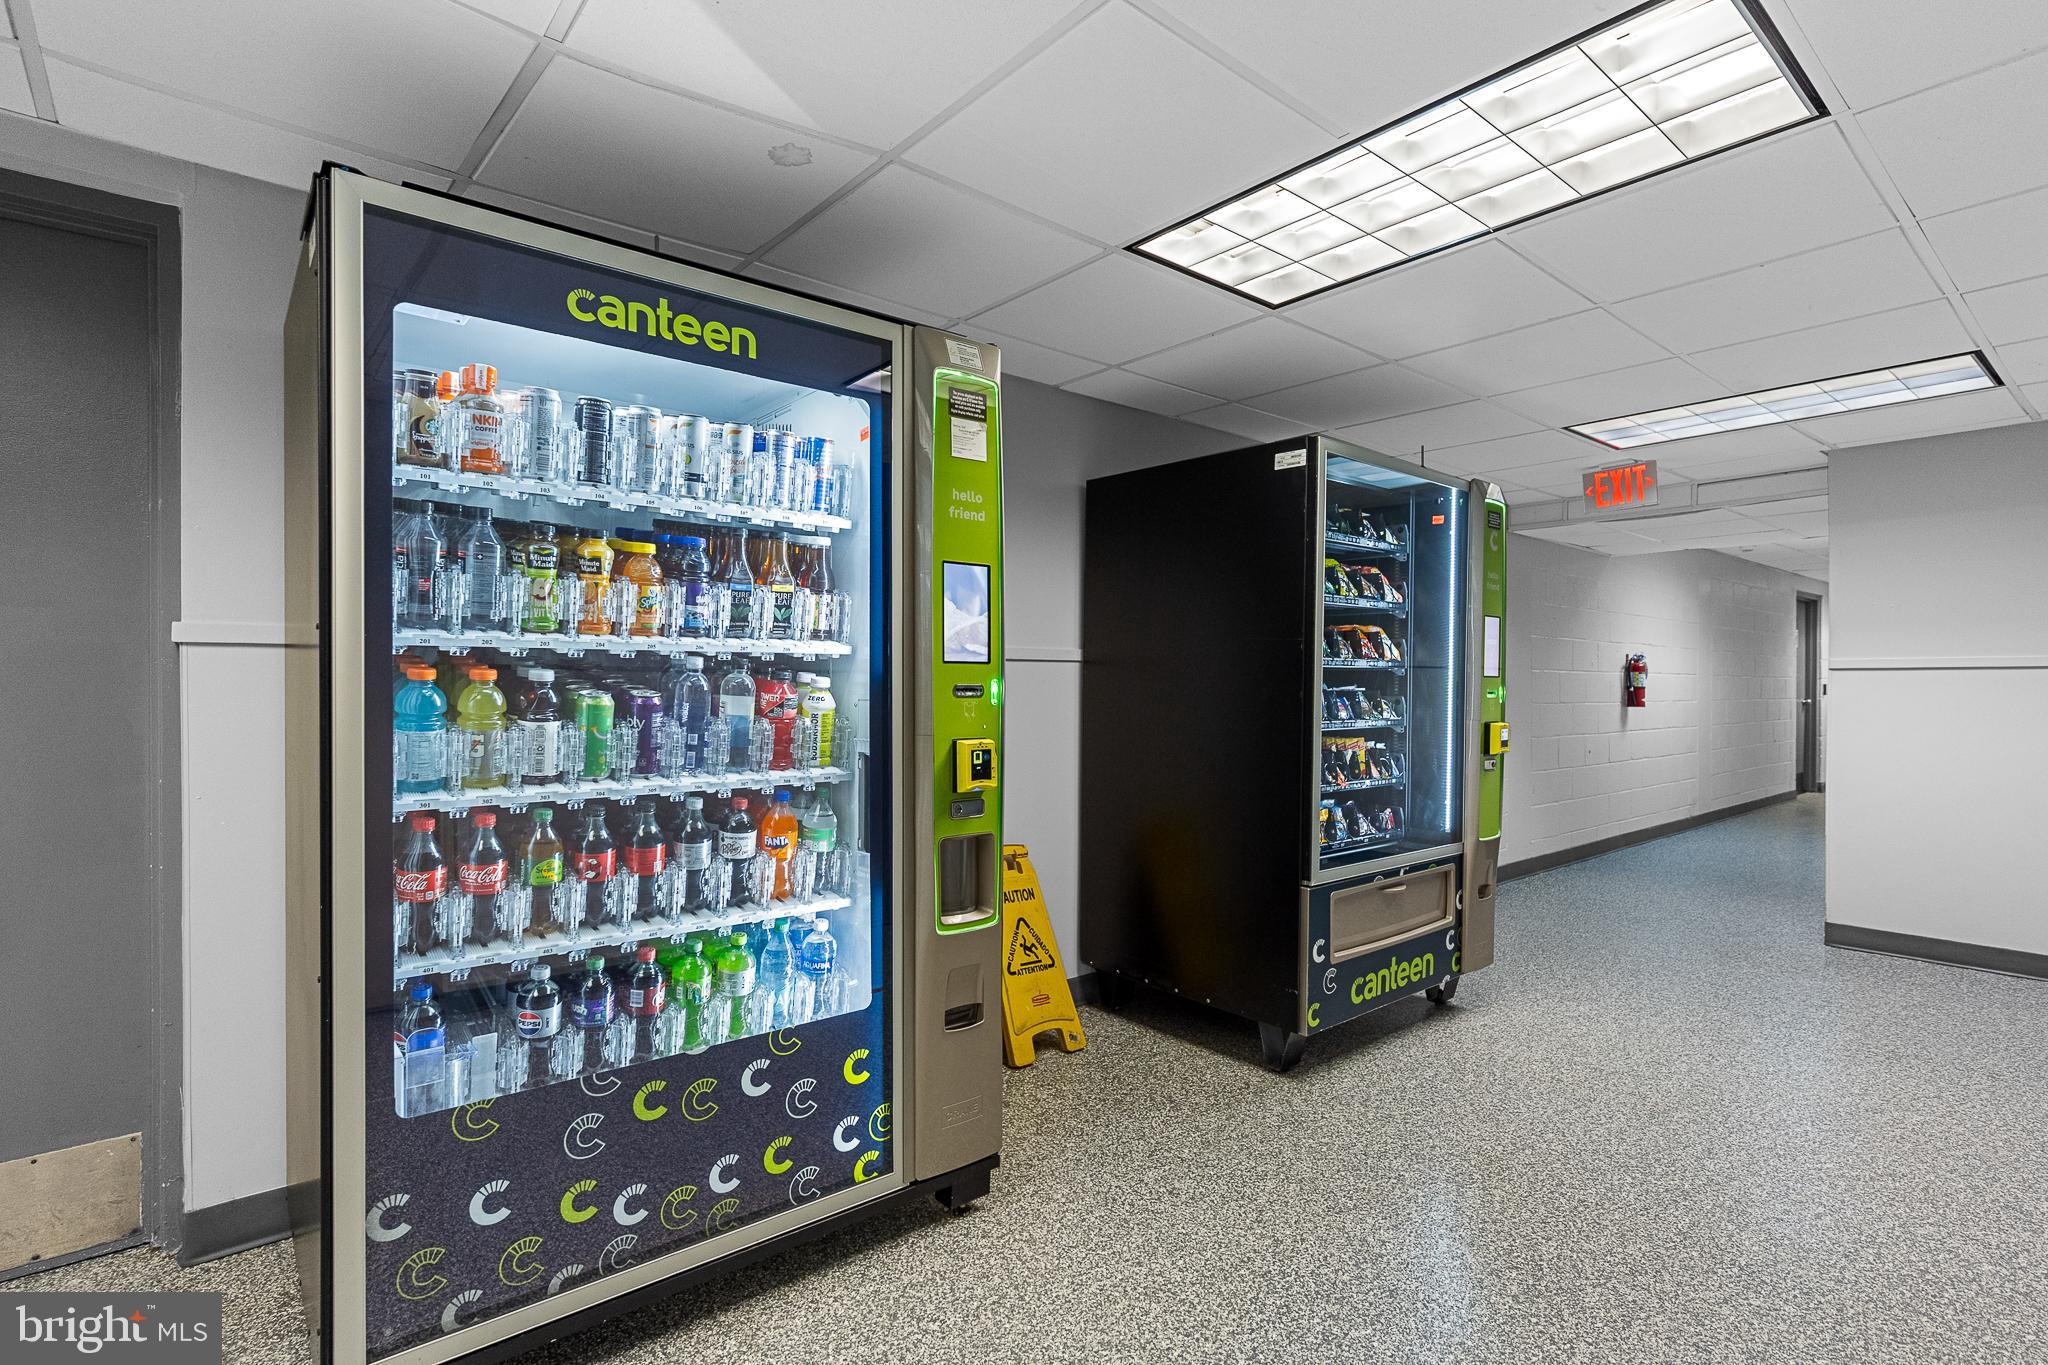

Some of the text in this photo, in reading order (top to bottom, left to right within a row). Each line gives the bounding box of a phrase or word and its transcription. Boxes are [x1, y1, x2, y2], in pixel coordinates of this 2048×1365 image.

[567, 288, 757, 359] canteen
[1594, 464, 1648, 508] EXIT
[952, 488, 983, 504] hello
[949, 506, 986, 522] friend
[530, 553, 556, 562] Minute
[533, 560, 554, 568] Maid
[579, 558, 600, 567] Minute
[581, 565, 598, 573] Maid
[774, 591, 792, 599] PURE
[764, 835, 790, 847] FANTA
[1003, 888, 1035, 904] AUTION
[1008, 930, 1020, 962] CAUTION
[1028, 928, 1050, 956] CUIDADO
[1016, 965, 1049, 977] ATTENTION
[1351, 953, 1434, 1004] canteen
[518, 1018, 542, 1028] PEPSI
